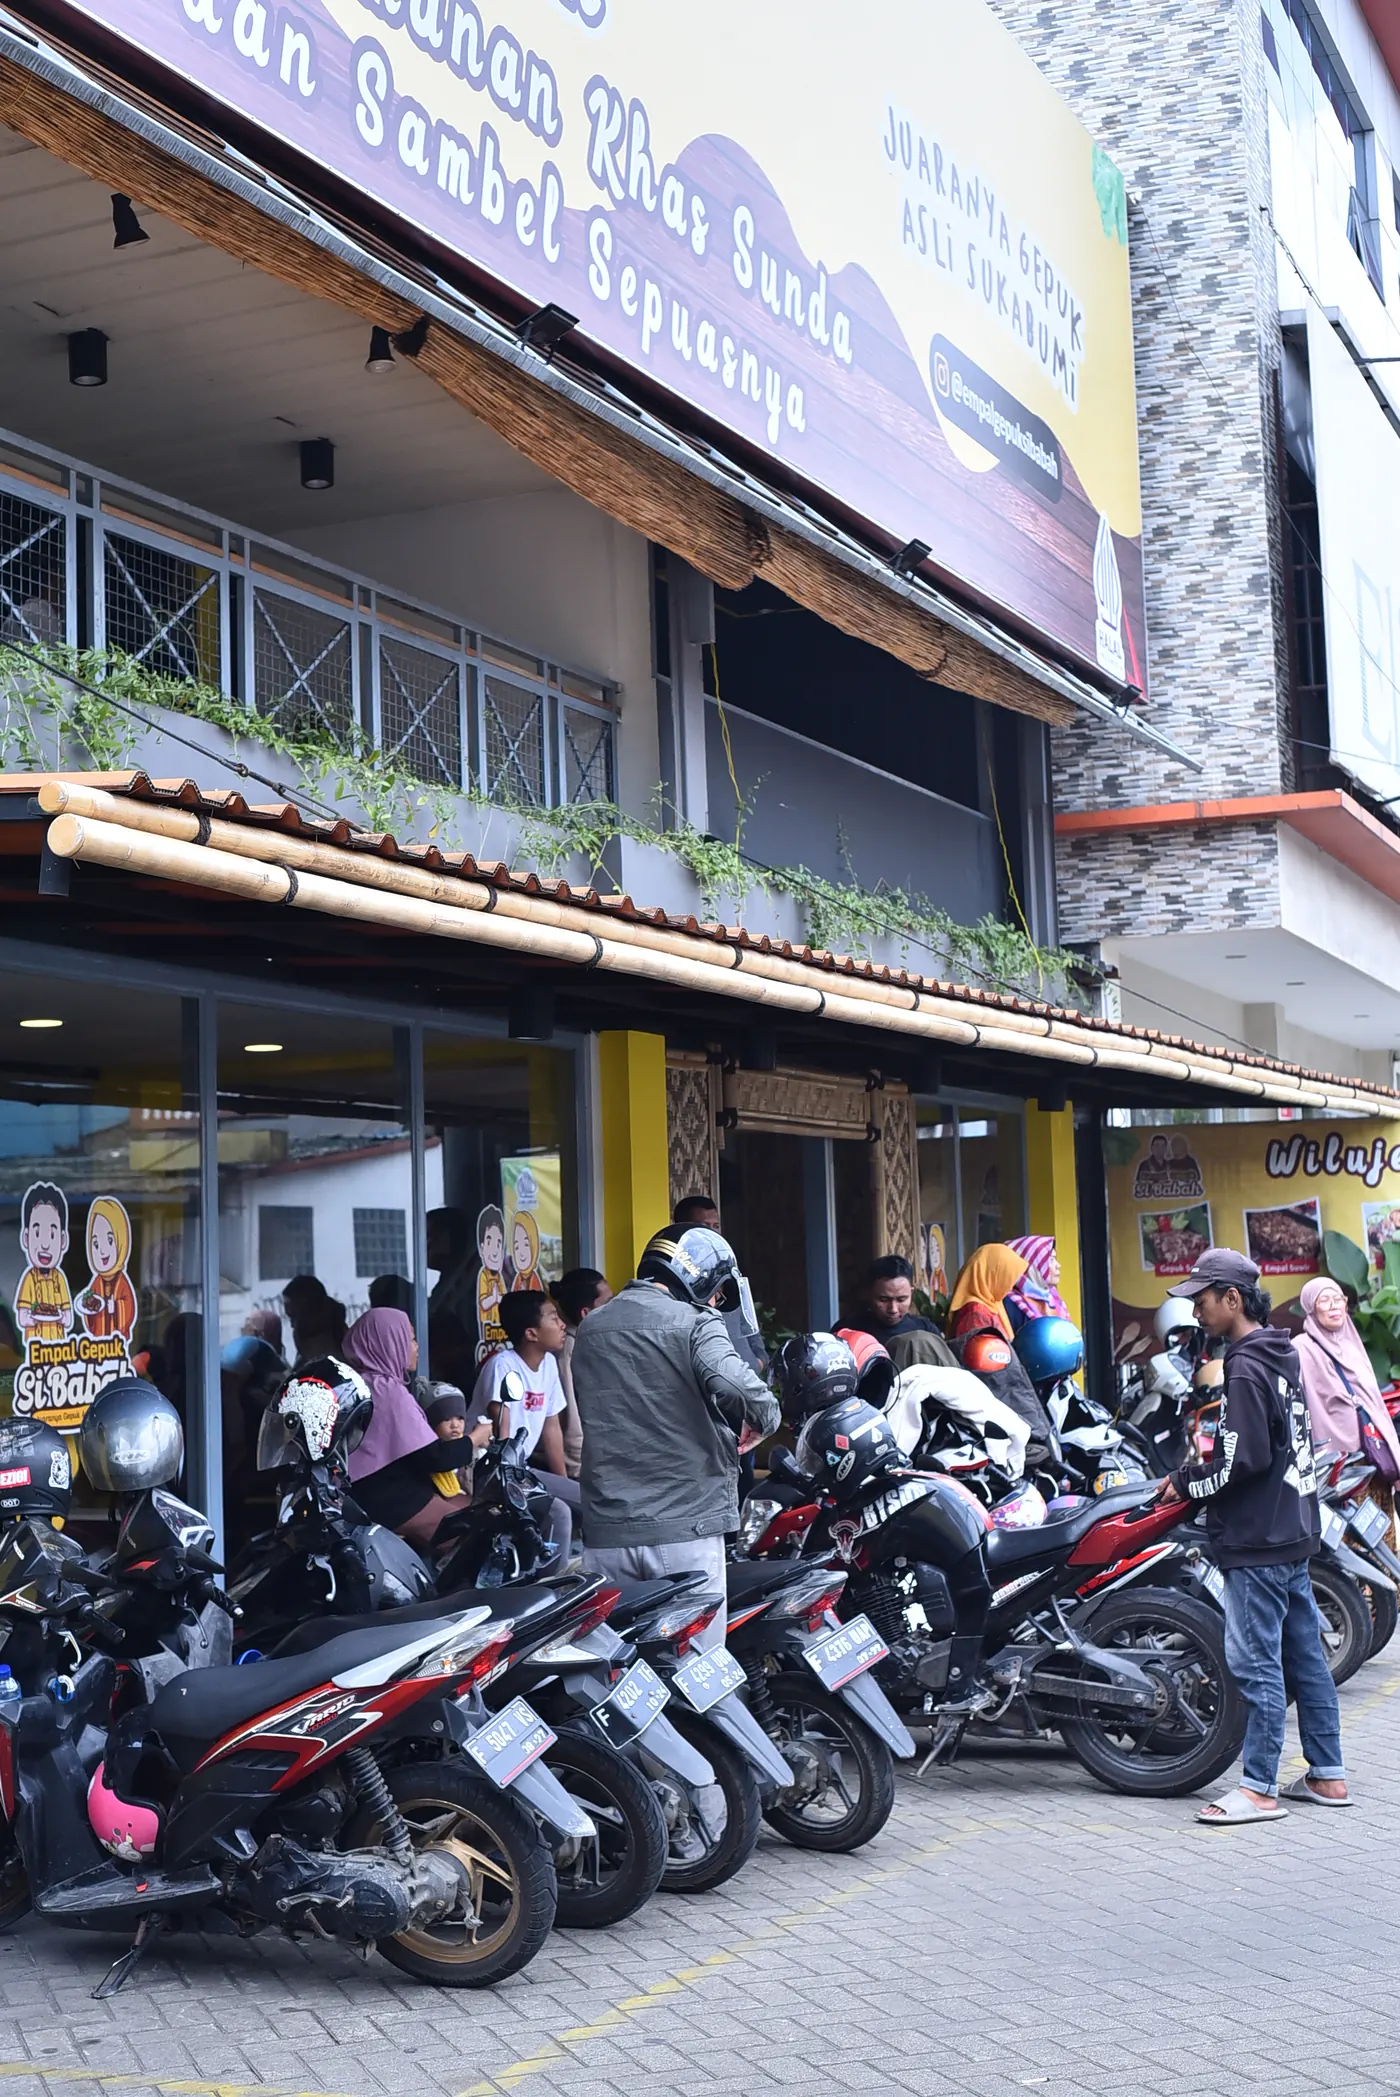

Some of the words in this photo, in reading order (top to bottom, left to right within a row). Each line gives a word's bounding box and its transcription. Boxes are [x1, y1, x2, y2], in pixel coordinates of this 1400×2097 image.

[373, 0, 559, 135] anan
[588, 87, 710, 256] Khas
[733, 205, 853, 364] Sunda
[355, 50, 560, 264] Sambel
[588, 217, 806, 445] Sepuasnya
[884, 105, 1011, 256] JUARANYA
[1019, 231, 1083, 353] GEPUK
[951, 371, 1059, 481] @empalgepuksibabah
[1265, 1263, 1289, 1274] Empal
[30, 1340, 77, 1366] Empal
[80, 1338, 125, 1363] Gepuk
[17, 1368, 47, 1412] Si
[838, 1451, 855, 1479] INK
[678, 1676, 691, 1693] F
[689, 1660, 716, 1683] 4299
[808, 1654, 823, 1673] F
[824, 1636, 853, 1662] 4376
[290, 1694, 356, 1734] VARIO
[596, 1708, 610, 1727] F
[616, 1680, 643, 1710] 4202
[471, 1745, 487, 1765] F
[485, 1720, 517, 1752] 5047
